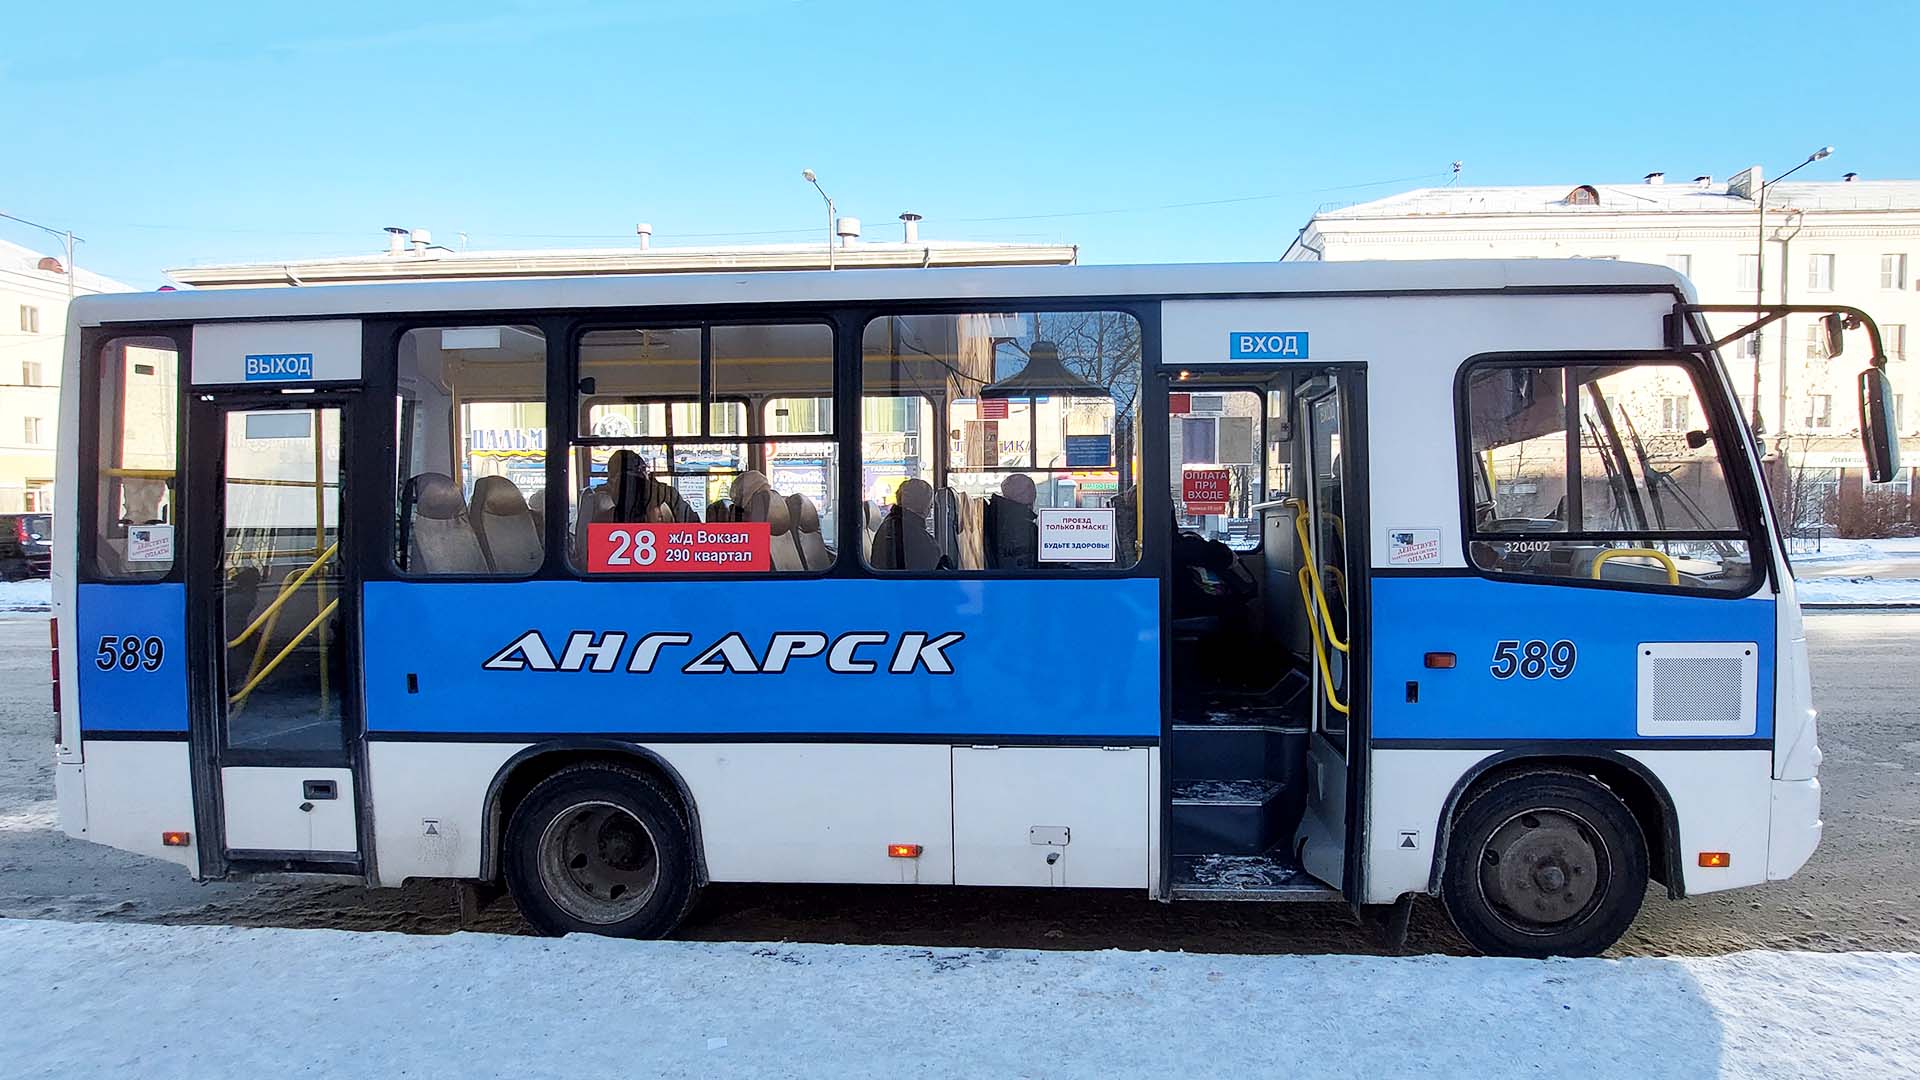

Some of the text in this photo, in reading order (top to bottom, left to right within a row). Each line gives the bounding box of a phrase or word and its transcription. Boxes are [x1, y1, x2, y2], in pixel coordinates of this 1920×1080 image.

[1240, 335, 1299, 356] ВХОД
[247, 357, 311, 376] ВЫХОД
[1184, 471, 1228, 480] ОПЛАТА
[1195, 481, 1217, 489] ПРИ
[1188, 490, 1224, 500] ВХОДЕ
[669, 531, 749, 545] ж/д Вокзал
[607, 530, 657, 566] 28
[1504, 541, 1551, 553] 320402
[666, 549, 753, 565] 290 квартал
[95, 635, 165, 672] 589
[481, 629, 966, 675] АНГАРСК
[1489, 639, 1578, 680] 589
